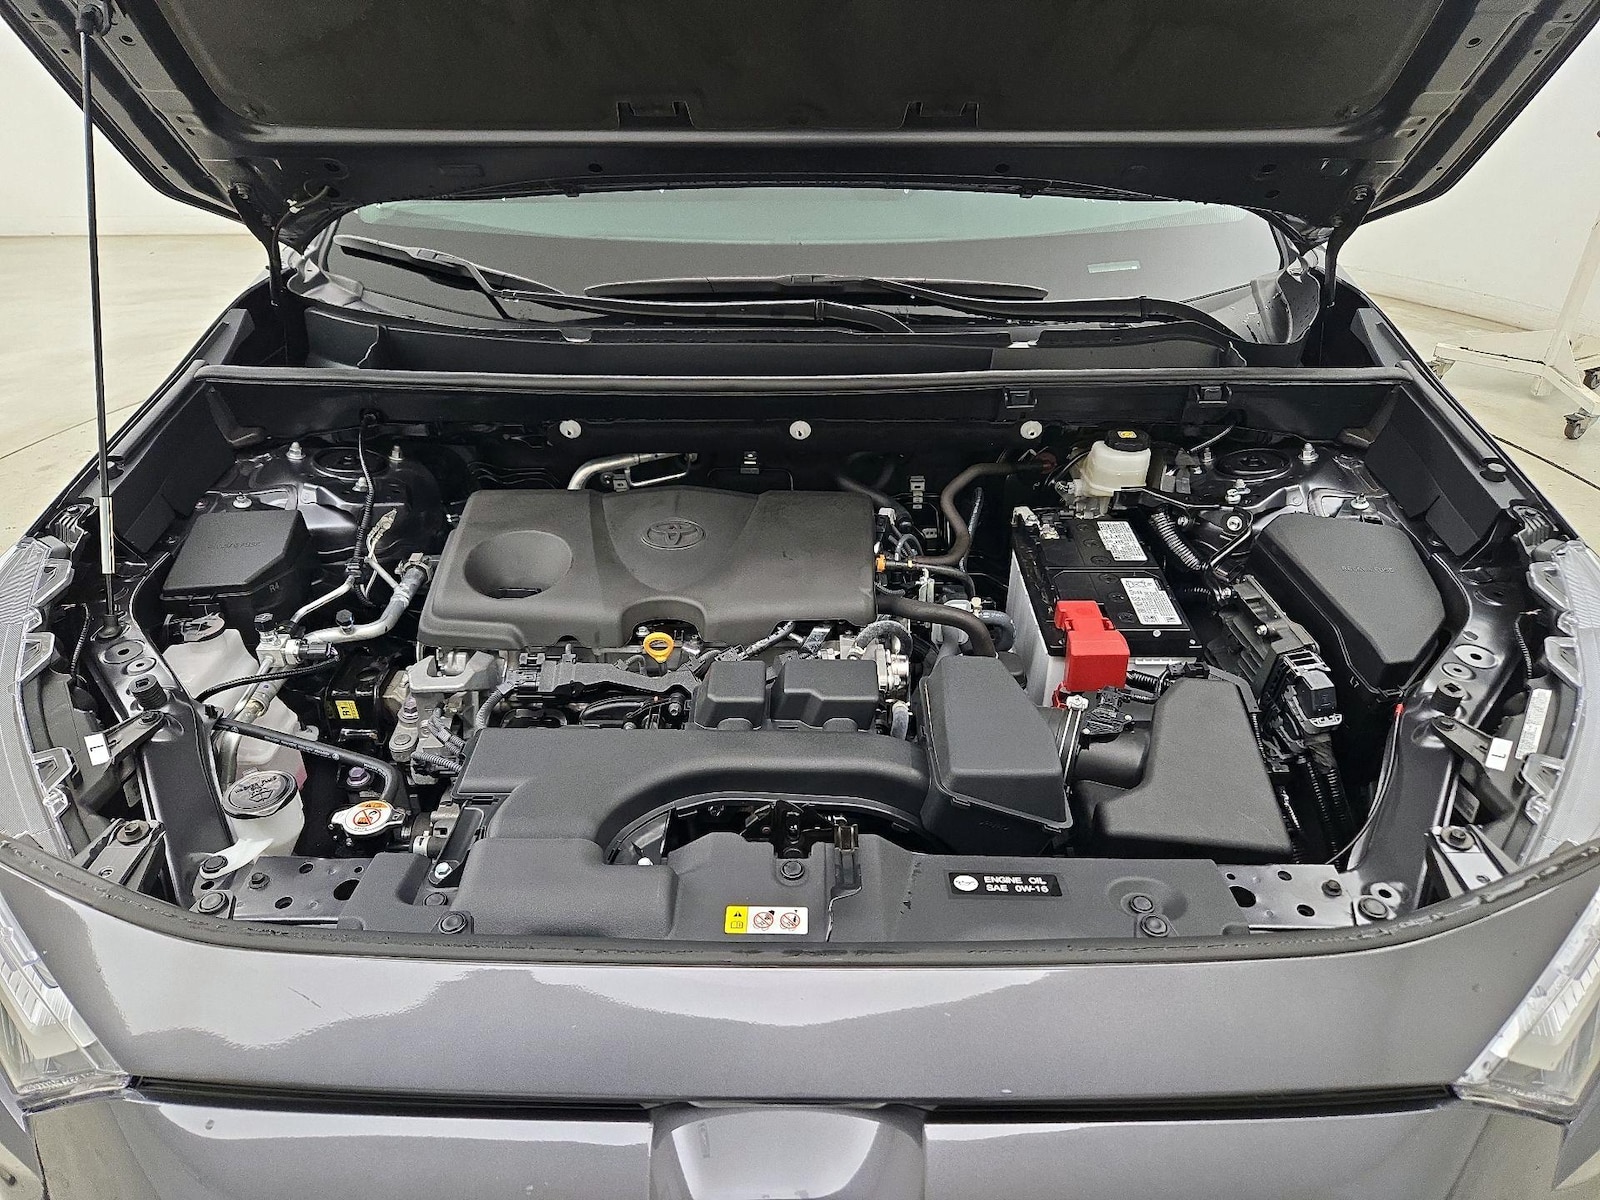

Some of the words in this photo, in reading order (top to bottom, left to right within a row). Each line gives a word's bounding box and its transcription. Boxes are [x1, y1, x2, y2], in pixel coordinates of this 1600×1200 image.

[983, 875, 1023, 884] ENGINE
[1027, 876, 1048, 885] OIL
[985, 883, 1009, 892] SAE
[1014, 884, 1050, 893] 0W-16
